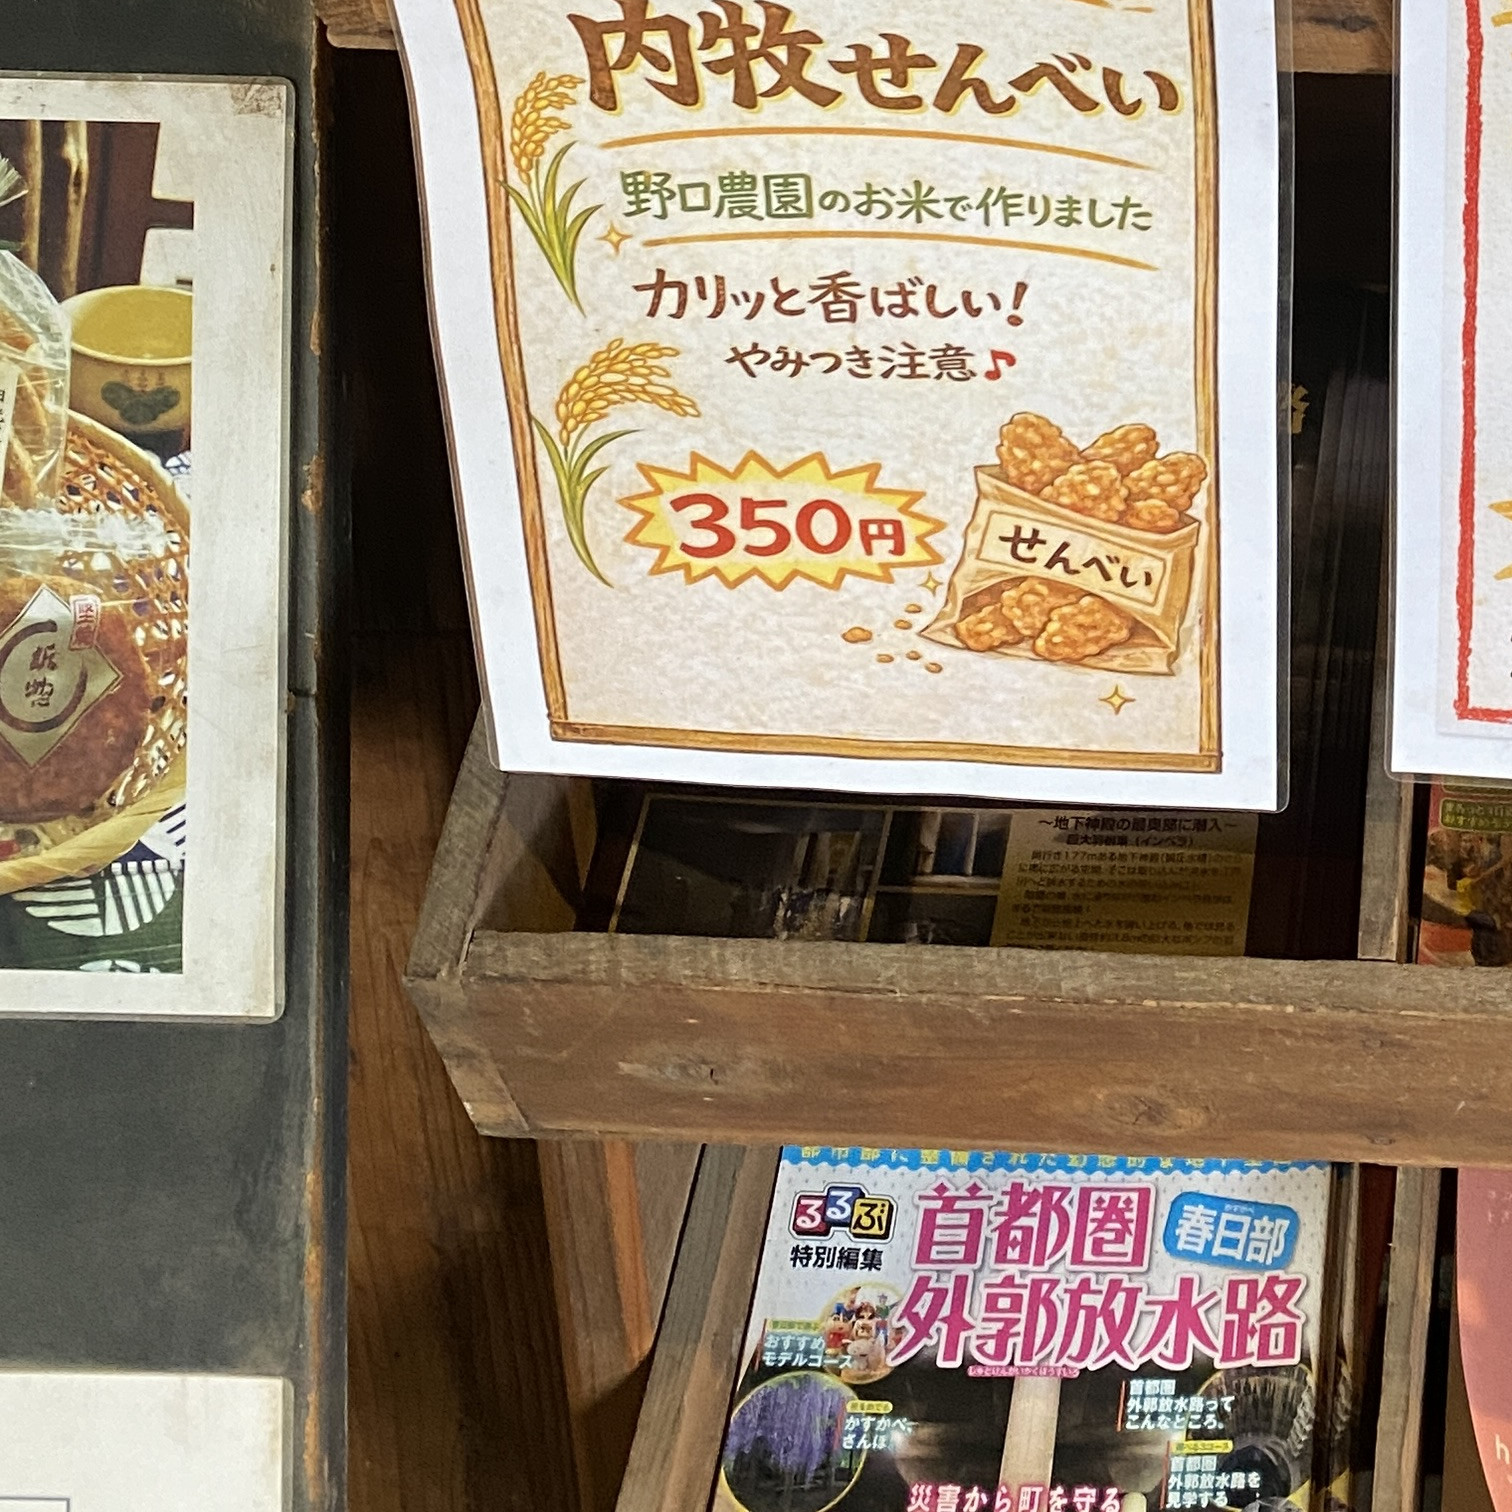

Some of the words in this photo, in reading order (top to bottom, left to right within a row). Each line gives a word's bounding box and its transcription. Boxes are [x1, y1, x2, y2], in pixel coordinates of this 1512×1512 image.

[620, 170, 1154, 232] 野口農園のお米で作りました
[668, 493, 907, 560] 350円
[999, 524, 1154, 590] せんべい
[796, 1186, 892, 1237] るるぶ
[915, 1180, 1155, 1268] 首都圏
[1174, 1205, 1291, 1266] 春日部
[790, 1246, 884, 1273] 特別編集
[892, 1274, 1309, 1367] 外郭放水路
[763, 1333, 825, 1351] おすすめ
[762, 1351, 852, 1369] モデルコース
[1129, 1379, 1177, 1396] 首都圏
[1126, 1395, 1236, 1414] 外郭放水路って
[1168, 1472, 1261, 1490] 外郭放水路を
[907, 1483, 1122, 1512] 災害から町を守る
[1165, 1490, 1229, 1509] 見学する
